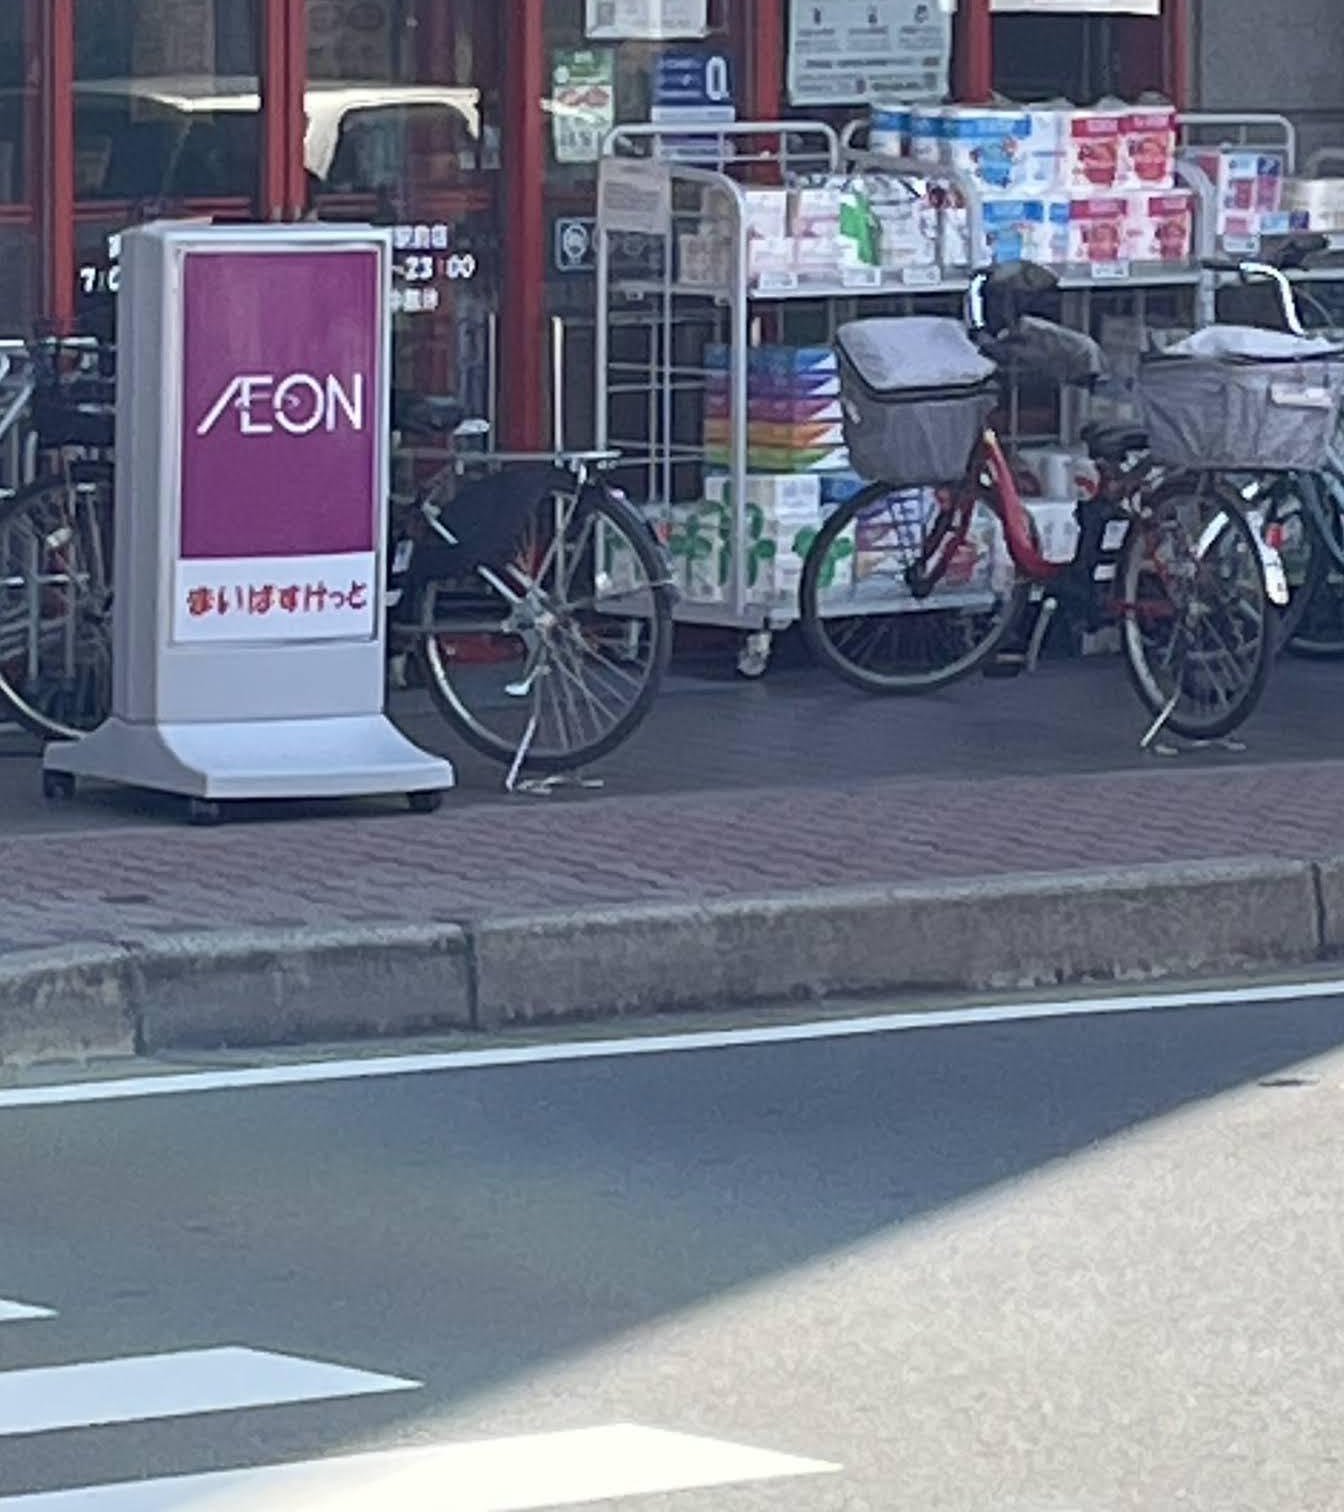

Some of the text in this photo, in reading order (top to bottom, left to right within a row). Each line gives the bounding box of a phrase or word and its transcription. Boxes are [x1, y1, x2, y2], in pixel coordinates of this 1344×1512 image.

[197, 373, 364, 435] AEON
[187, 581, 368, 617] まいばすけっと
